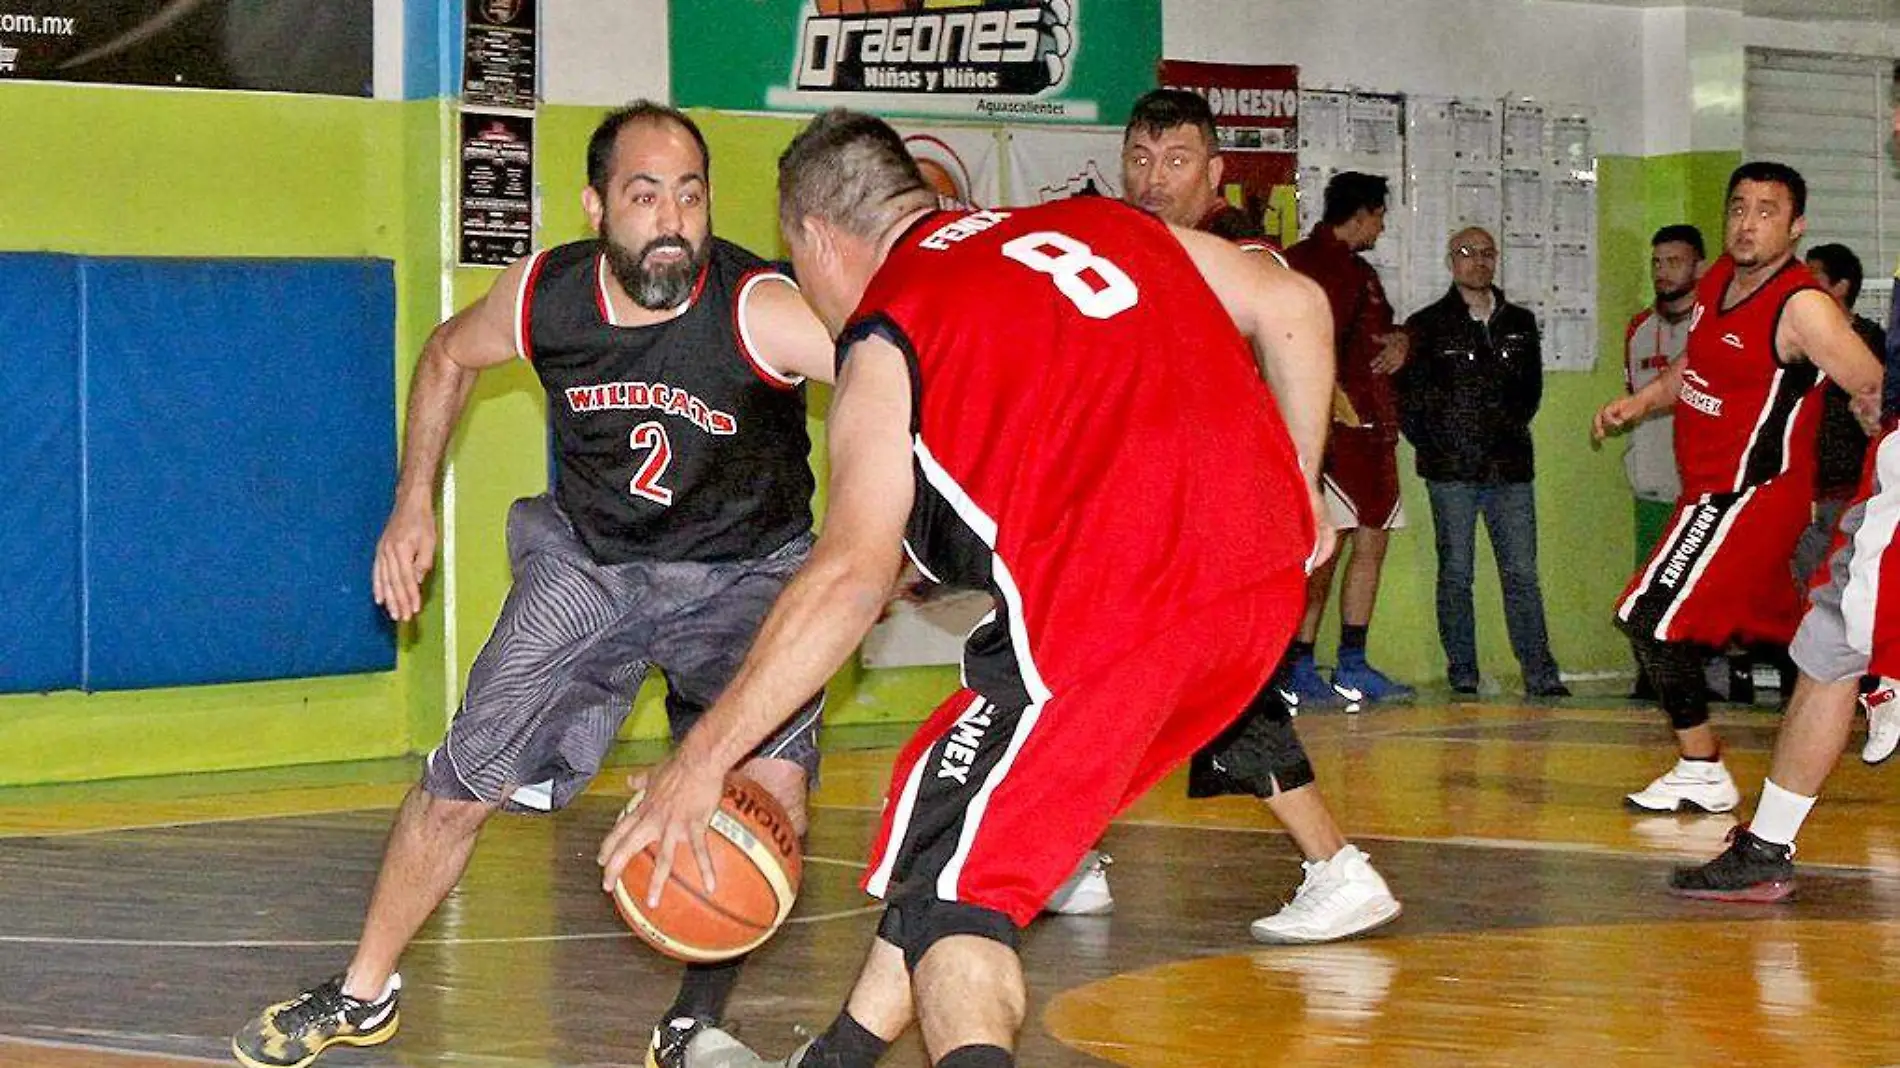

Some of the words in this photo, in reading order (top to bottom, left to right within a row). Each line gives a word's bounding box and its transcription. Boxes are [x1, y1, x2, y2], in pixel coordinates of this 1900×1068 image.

[0, 14, 74, 36] om.mx
[863, 66, 920, 88] Niñas
[925, 70, 939, 91] y
[943, 68, 998, 89] Niños
[976, 98, 1065, 116] Aguascalientes
[1162, 86, 1297, 117] ONCESTO
[1001, 231, 1139, 319] 8
[565, 382, 738, 435] WILDCATS
[630, 421, 672, 506] 2
[1659, 504, 1718, 588] ARRENDAMEX
